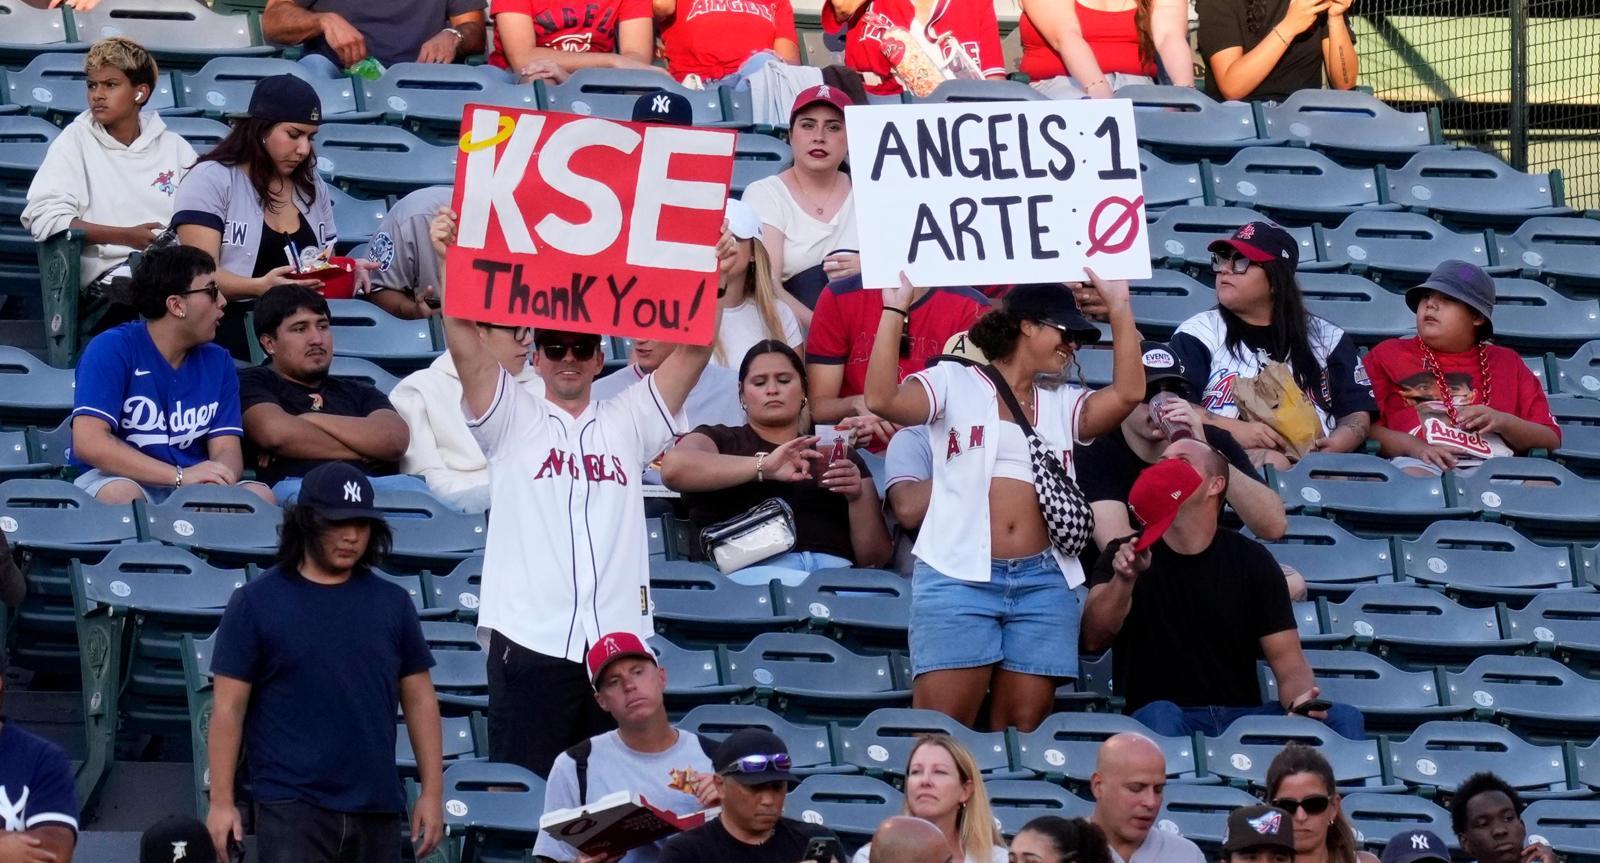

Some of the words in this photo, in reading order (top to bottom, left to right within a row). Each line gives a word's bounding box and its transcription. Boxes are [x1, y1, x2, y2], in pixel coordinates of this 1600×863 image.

[535, 4, 614, 37] NGEL
[1095, 116, 1137, 180] 1
[457, 109, 735, 272] KSE
[607, 274, 706, 332] You!
[1145, 352, 1171, 361] EVENTS
[121, 396, 219, 449] Dodger
[1431, 419, 1489, 449] Angels
[343, 480, 362, 503] NY
